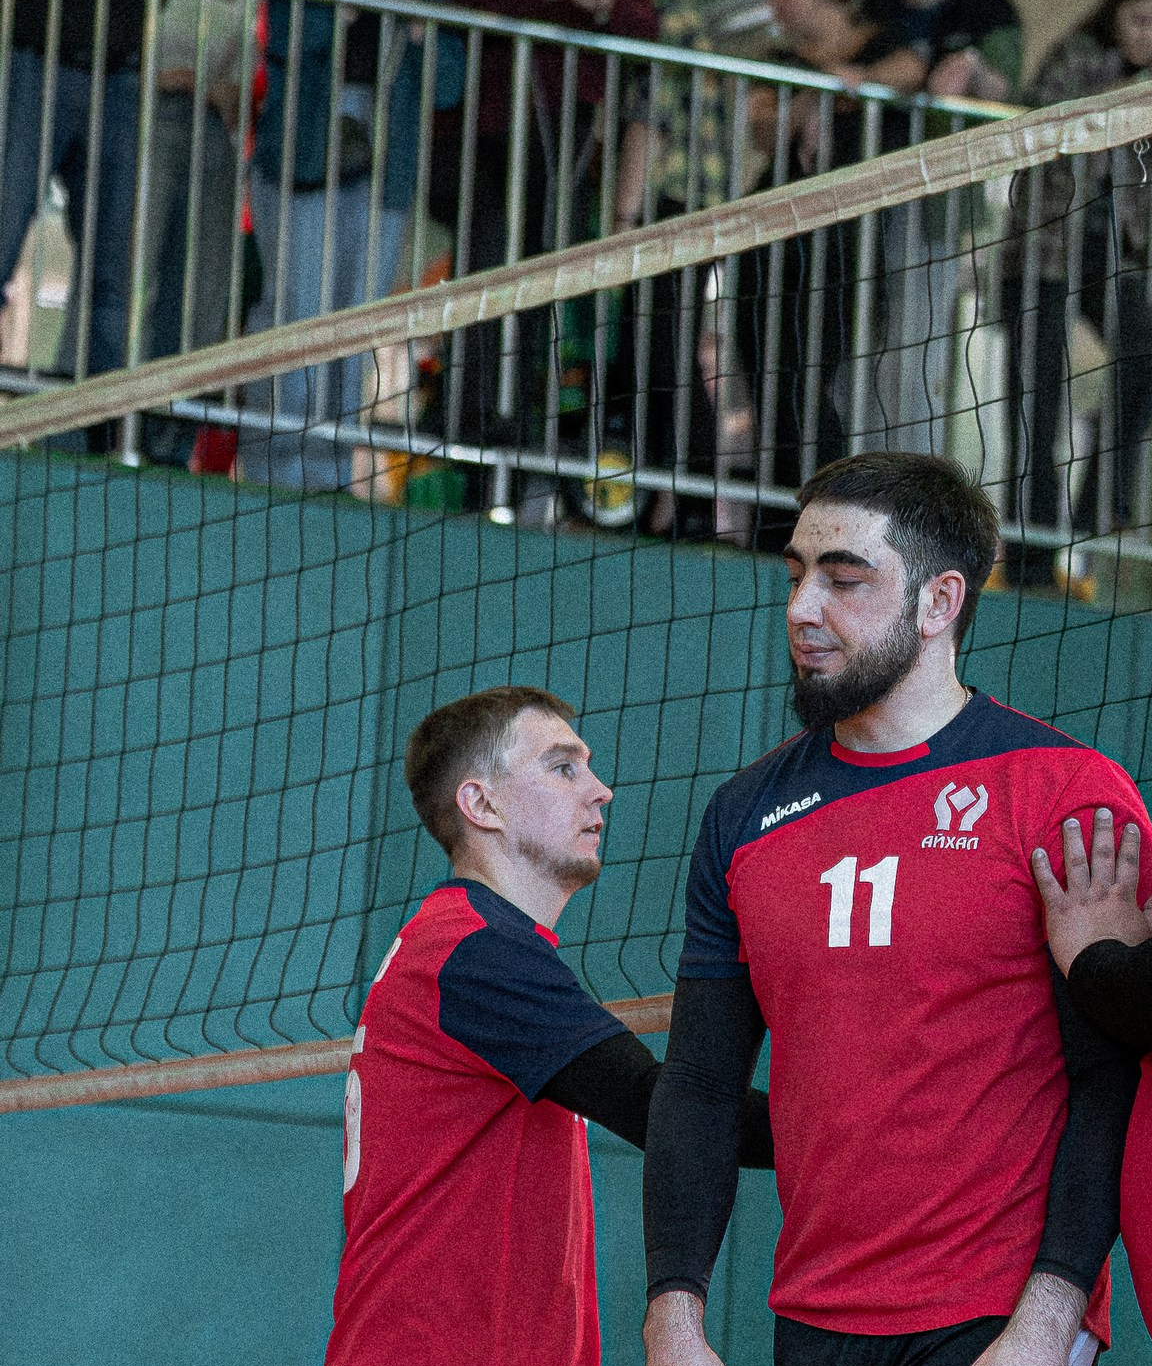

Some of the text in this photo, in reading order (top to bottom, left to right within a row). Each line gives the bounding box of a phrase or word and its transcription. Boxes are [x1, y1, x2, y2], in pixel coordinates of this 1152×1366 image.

[760, 792, 821, 831] MIKASA
[921, 833, 979, 851] АЙХАЛ
[819, 856, 899, 947] 11
